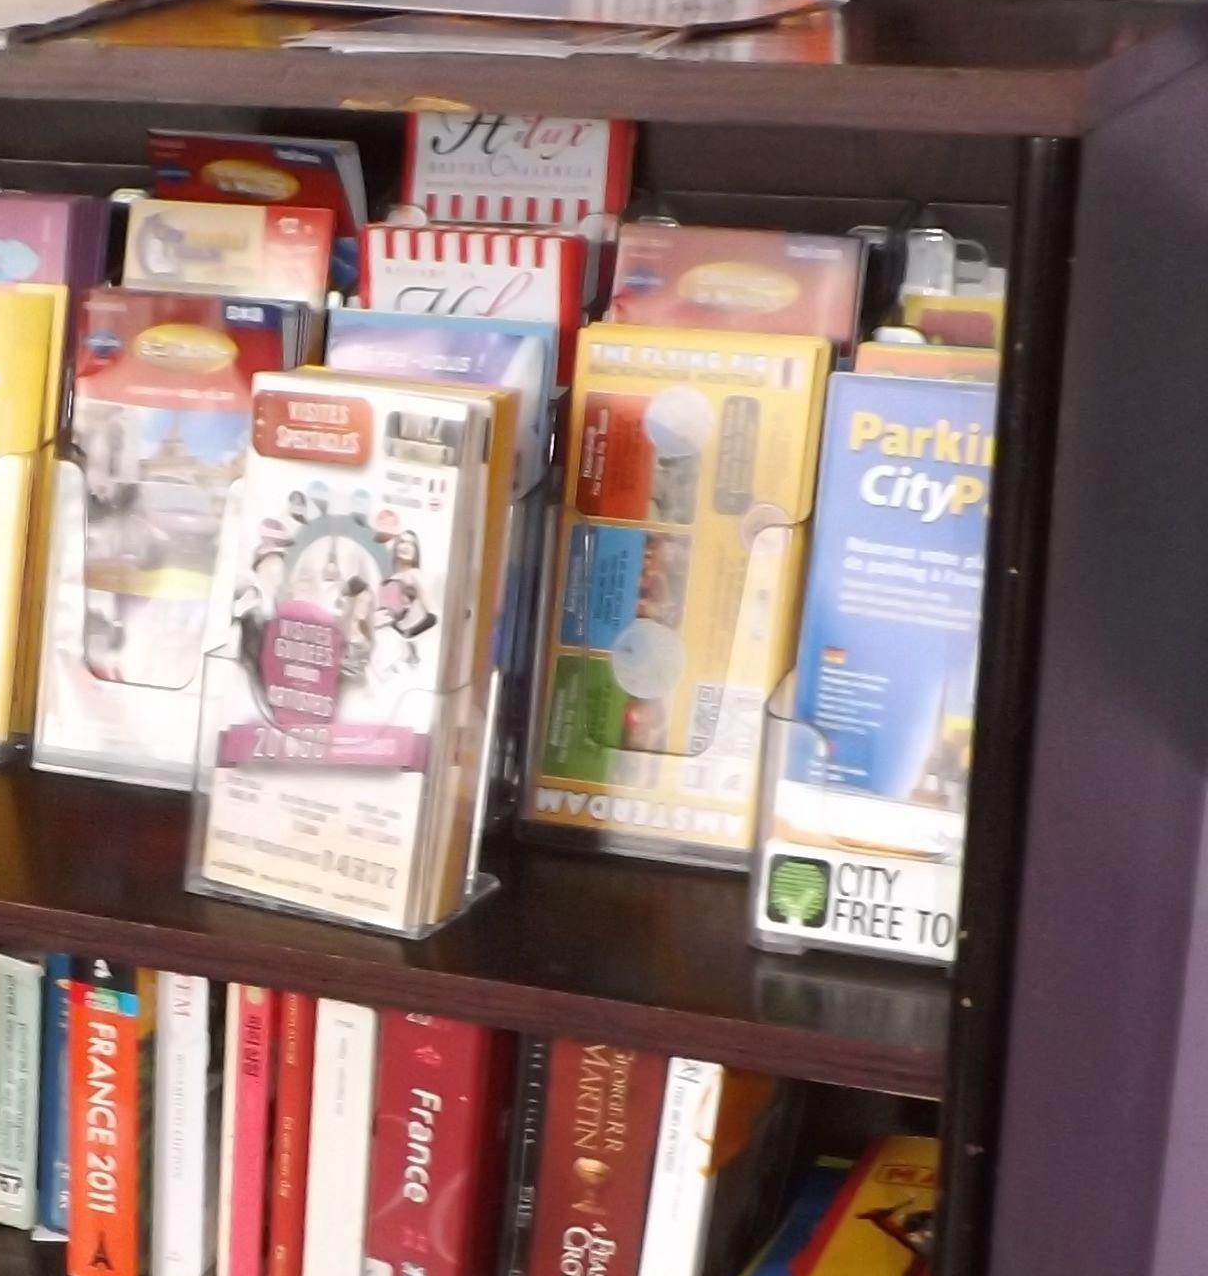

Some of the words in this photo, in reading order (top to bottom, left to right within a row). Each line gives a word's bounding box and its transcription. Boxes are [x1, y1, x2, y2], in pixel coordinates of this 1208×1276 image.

[590, 342, 634, 364] THE
[859, 464, 994, 523] CityP
[834, 862, 902, 900] CITY
[831, 898, 905, 943] FREE
[85, 1021, 120, 1146] FRANCE
[572, 1043, 609, 1152] MARTIN
[403, 1087, 443, 1204] France
[85, 1152, 119, 1215] 2011
